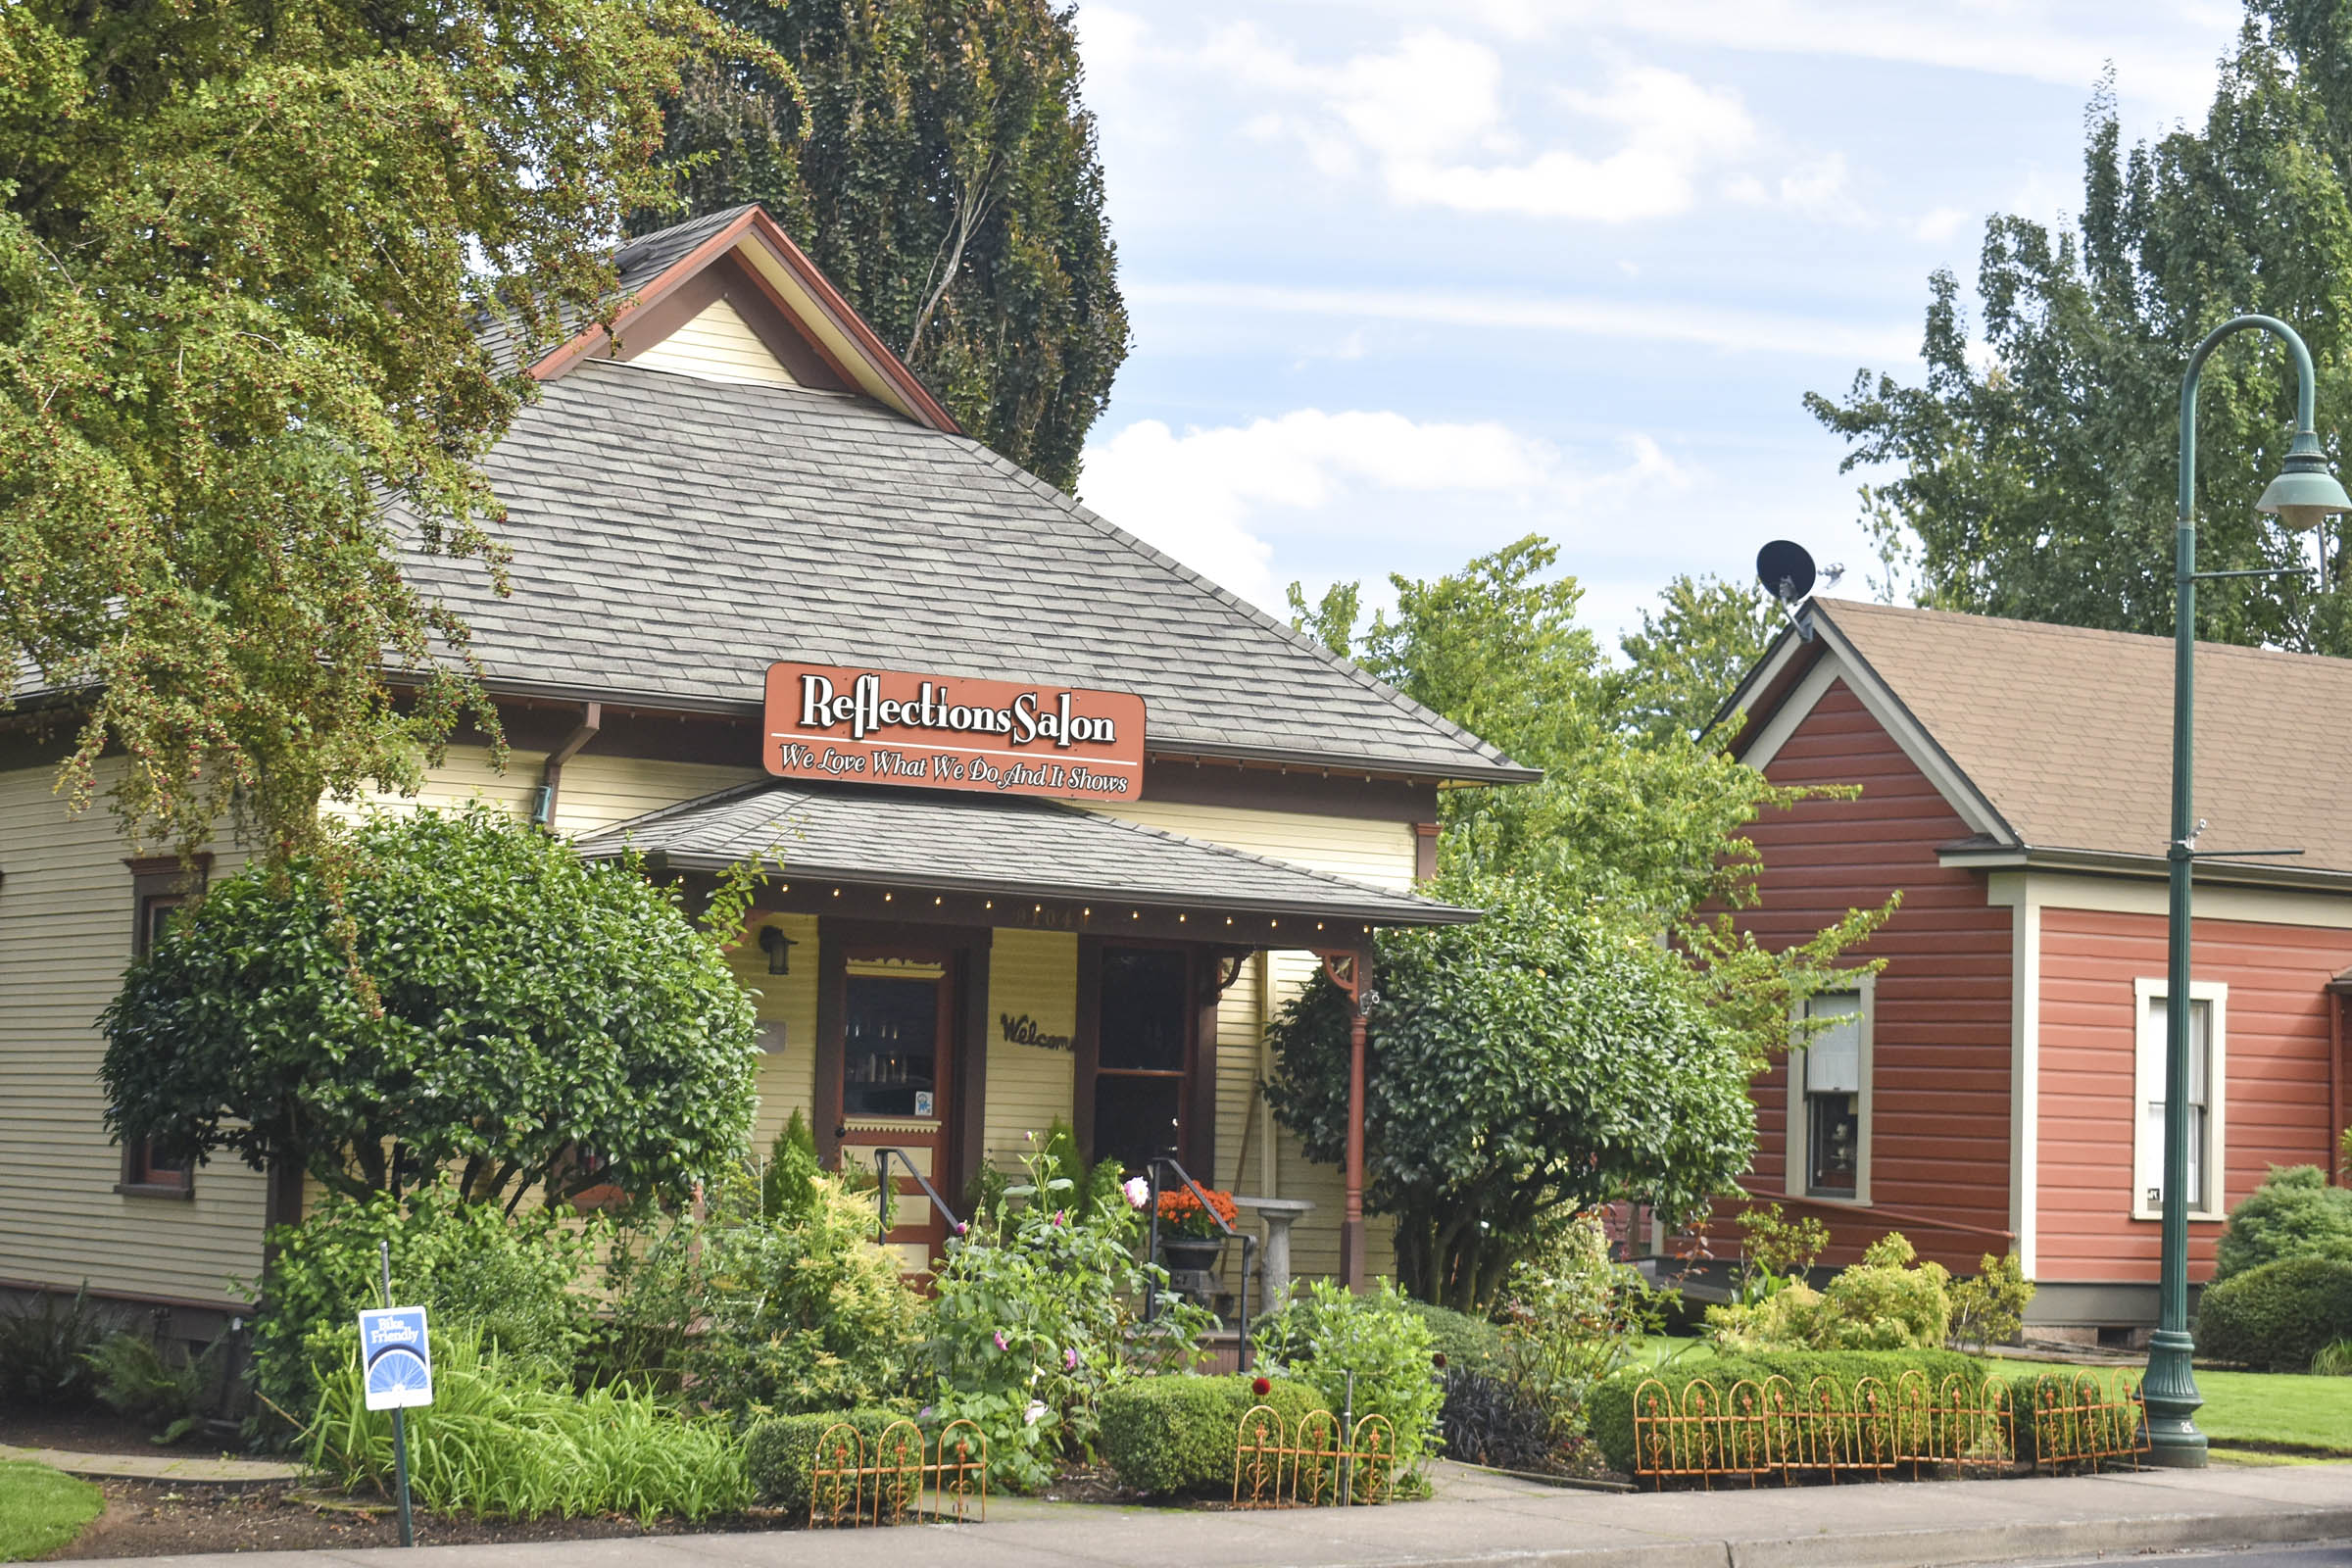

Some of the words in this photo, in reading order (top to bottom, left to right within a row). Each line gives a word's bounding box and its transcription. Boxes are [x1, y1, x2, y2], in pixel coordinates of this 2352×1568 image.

[780, 742, 814, 770] We
[816, 747, 866, 775] Love
[871, 750, 928, 777] What
[932, 756, 965, 782] We
[968, 757, 999, 782] Do
[997, 762, 1047, 789] And
[1048, 764, 1066, 788] It
[1067, 765, 1128, 793] Shows
[1001, 1012, 1075, 1052] Welcom
[370, 1326, 418, 1344] Friendly
[377, 1316, 405, 1331] Bike
